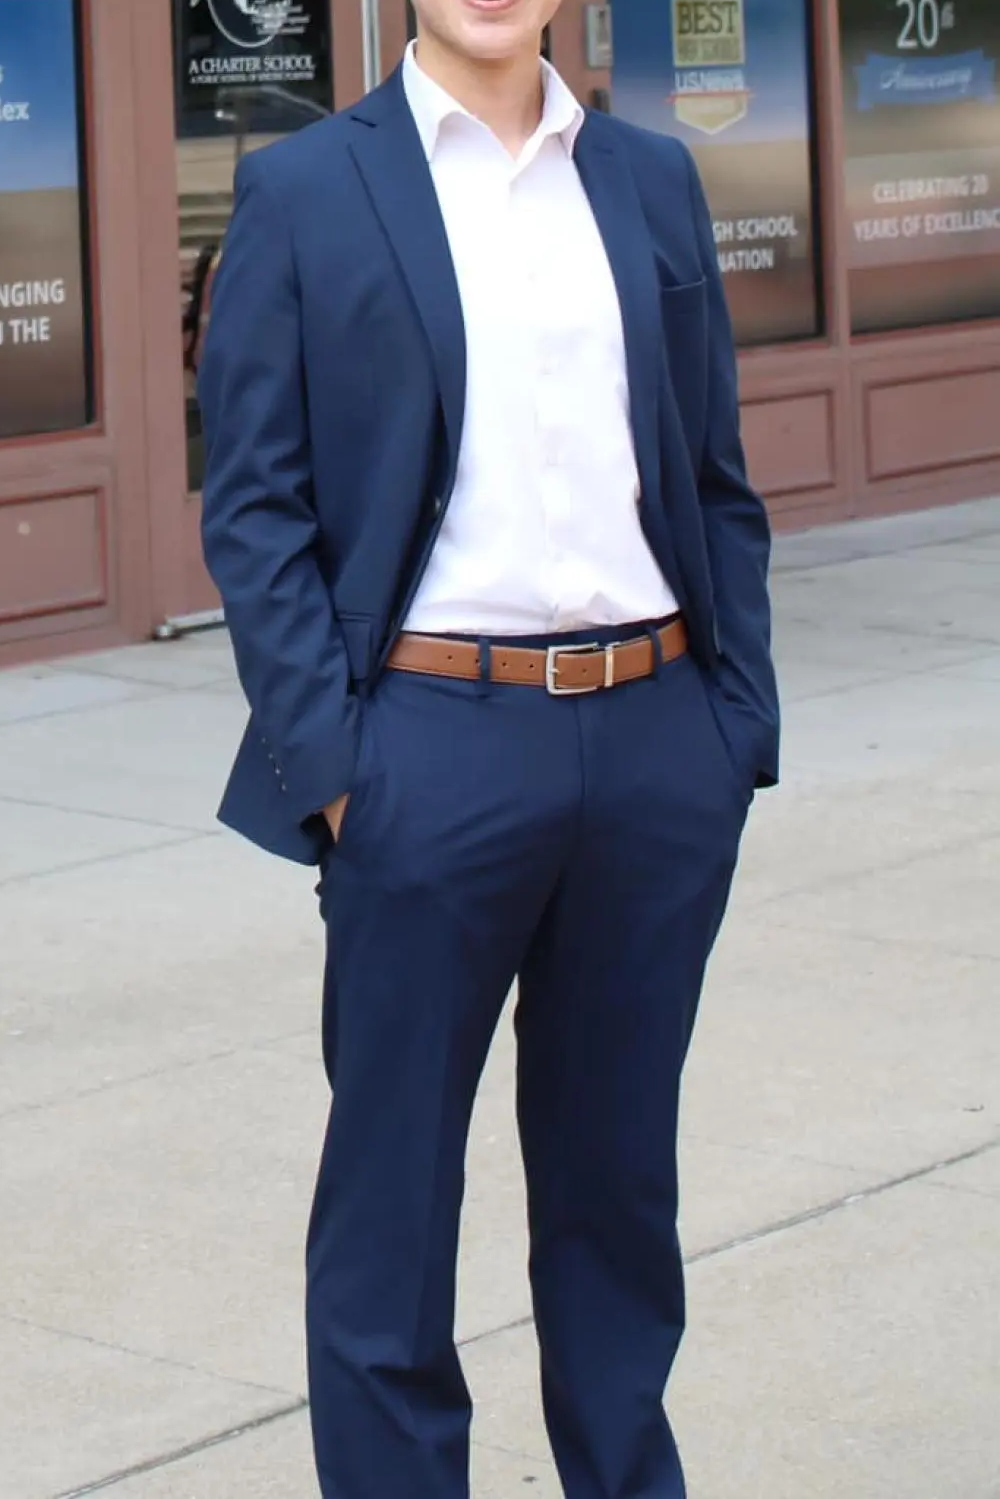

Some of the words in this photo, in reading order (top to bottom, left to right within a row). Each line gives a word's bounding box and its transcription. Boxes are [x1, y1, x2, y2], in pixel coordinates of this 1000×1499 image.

[677, 0, 738, 35] BEST
[188, 58, 200, 75] A
[201, 56, 262, 74] CHARTER
[263, 54, 316, 72] SCHOOL
[737, 215, 798, 241] SCHOOL
[9, 316, 51, 344] THE
